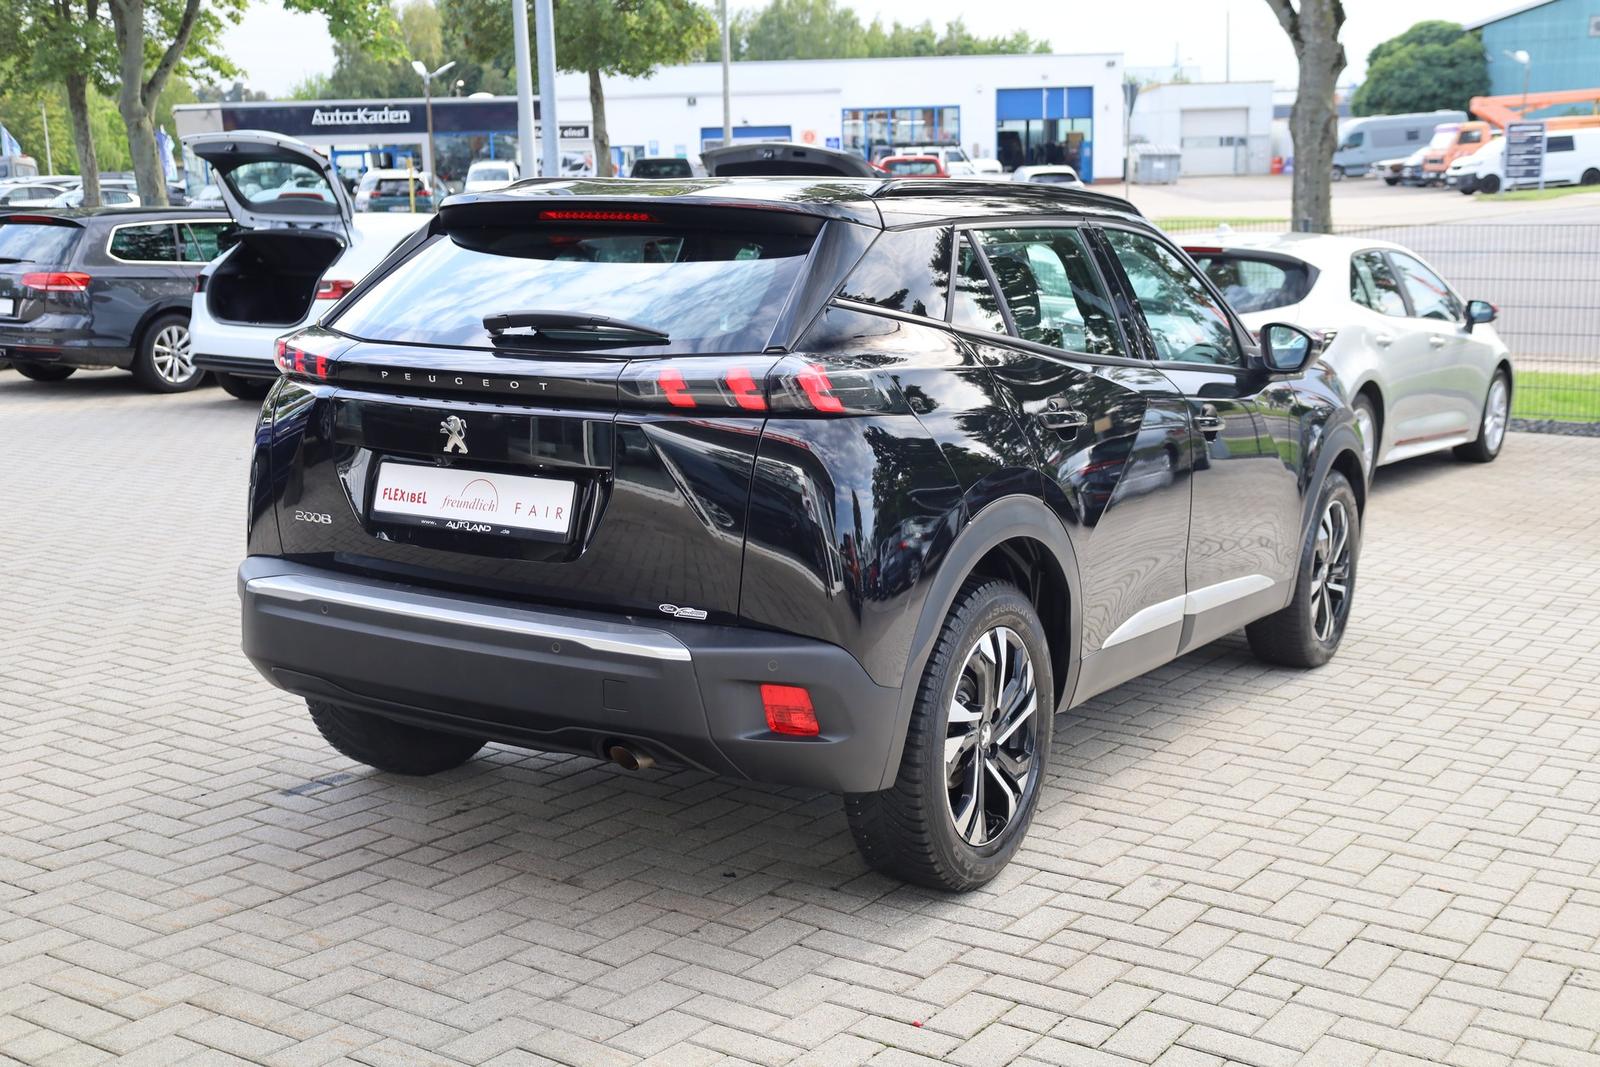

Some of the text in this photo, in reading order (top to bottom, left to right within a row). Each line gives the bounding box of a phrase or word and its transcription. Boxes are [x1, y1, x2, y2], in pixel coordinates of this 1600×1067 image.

[311, 106, 411, 125] Auto Kaden
[381, 371, 548, 391] PEUGEOT
[295, 510, 332, 524] 2008
[440, 495, 497, 512] freundlich
[514, 502, 564, 520] FAIR
